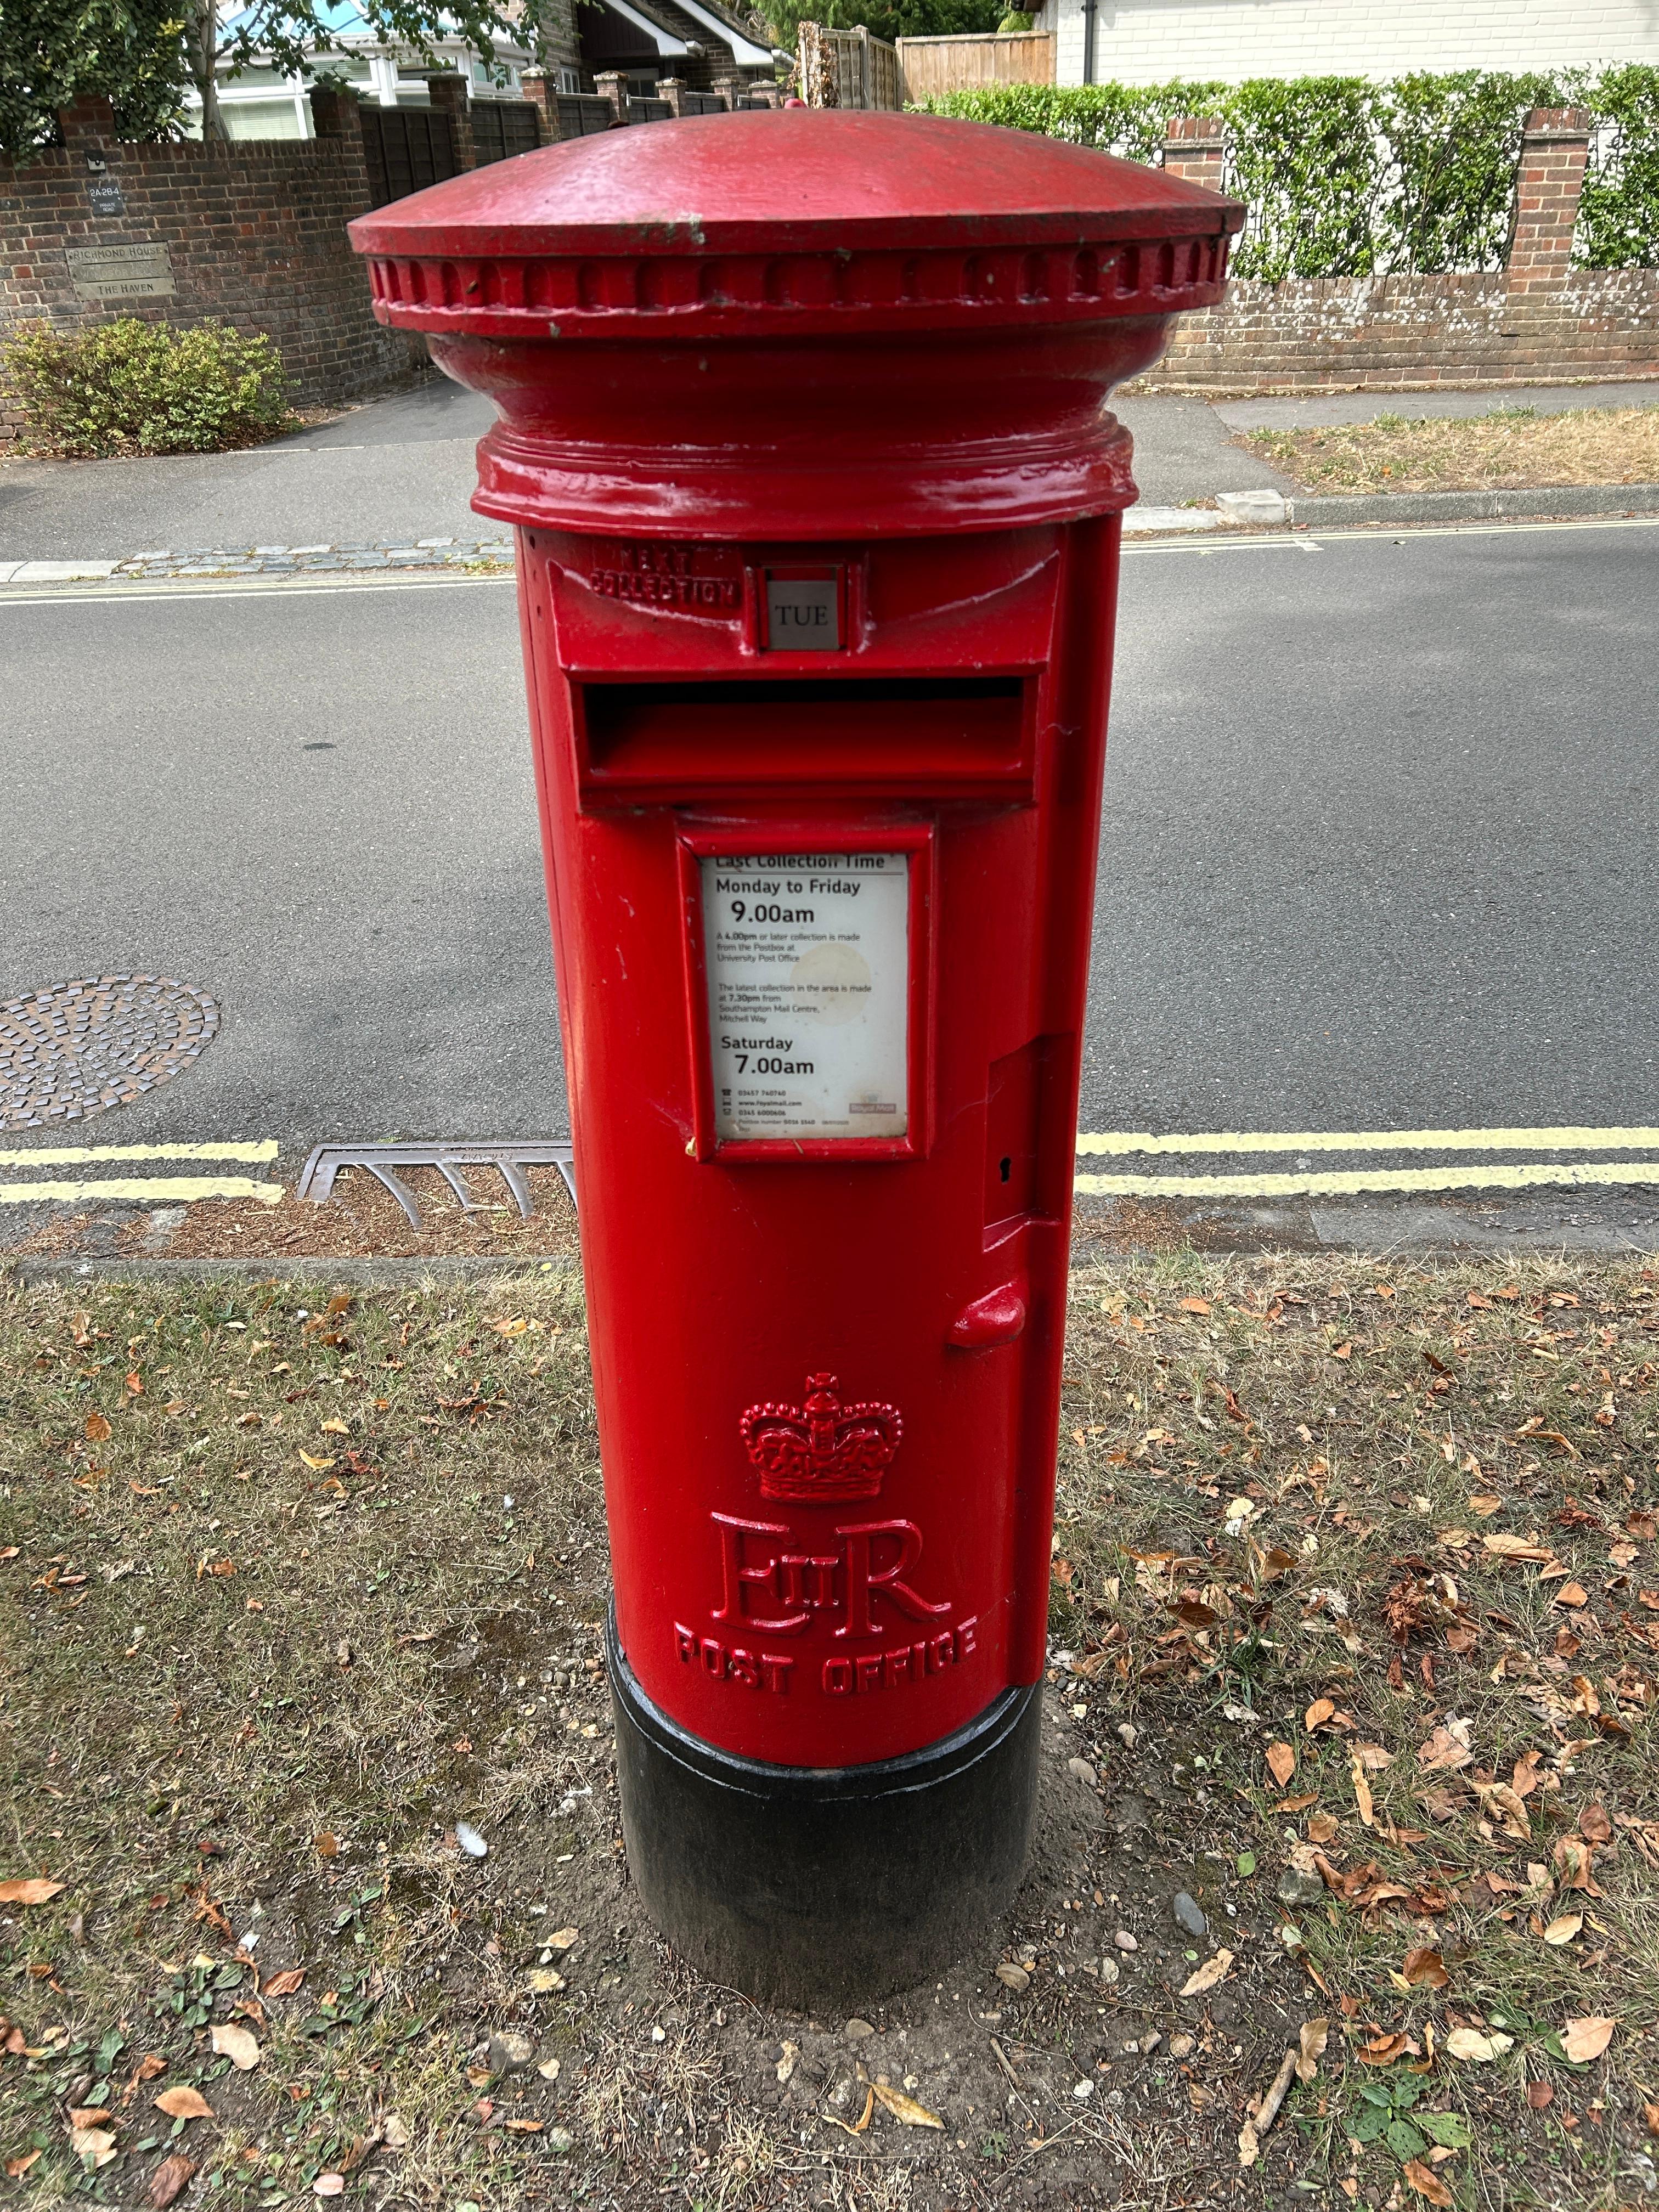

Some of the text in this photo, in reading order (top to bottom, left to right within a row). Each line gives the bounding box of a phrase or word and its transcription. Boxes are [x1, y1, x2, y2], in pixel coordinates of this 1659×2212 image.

[74, 246, 161, 259] RICHMOND HOUSE
[97, 283, 154, 295] THE HAVEN
[775, 605, 828, 626] TUE
[716, 854, 884, 868] Last Collection Time
[716, 879, 860, 896] Monday to Friday
[731, 901, 814, 922] 9.00am
[726, 934, 757, 942] 4.00pm
[718, 955, 755, 963] University
[729, 995, 760, 1003] 7.30pm
[751, 1016, 766, 1024] Way
[721, 1036, 793, 1052] Saturday
[735, 1055, 814, 1074] 7.00am
[674, 1616, 978, 1696] POST OFFICE
